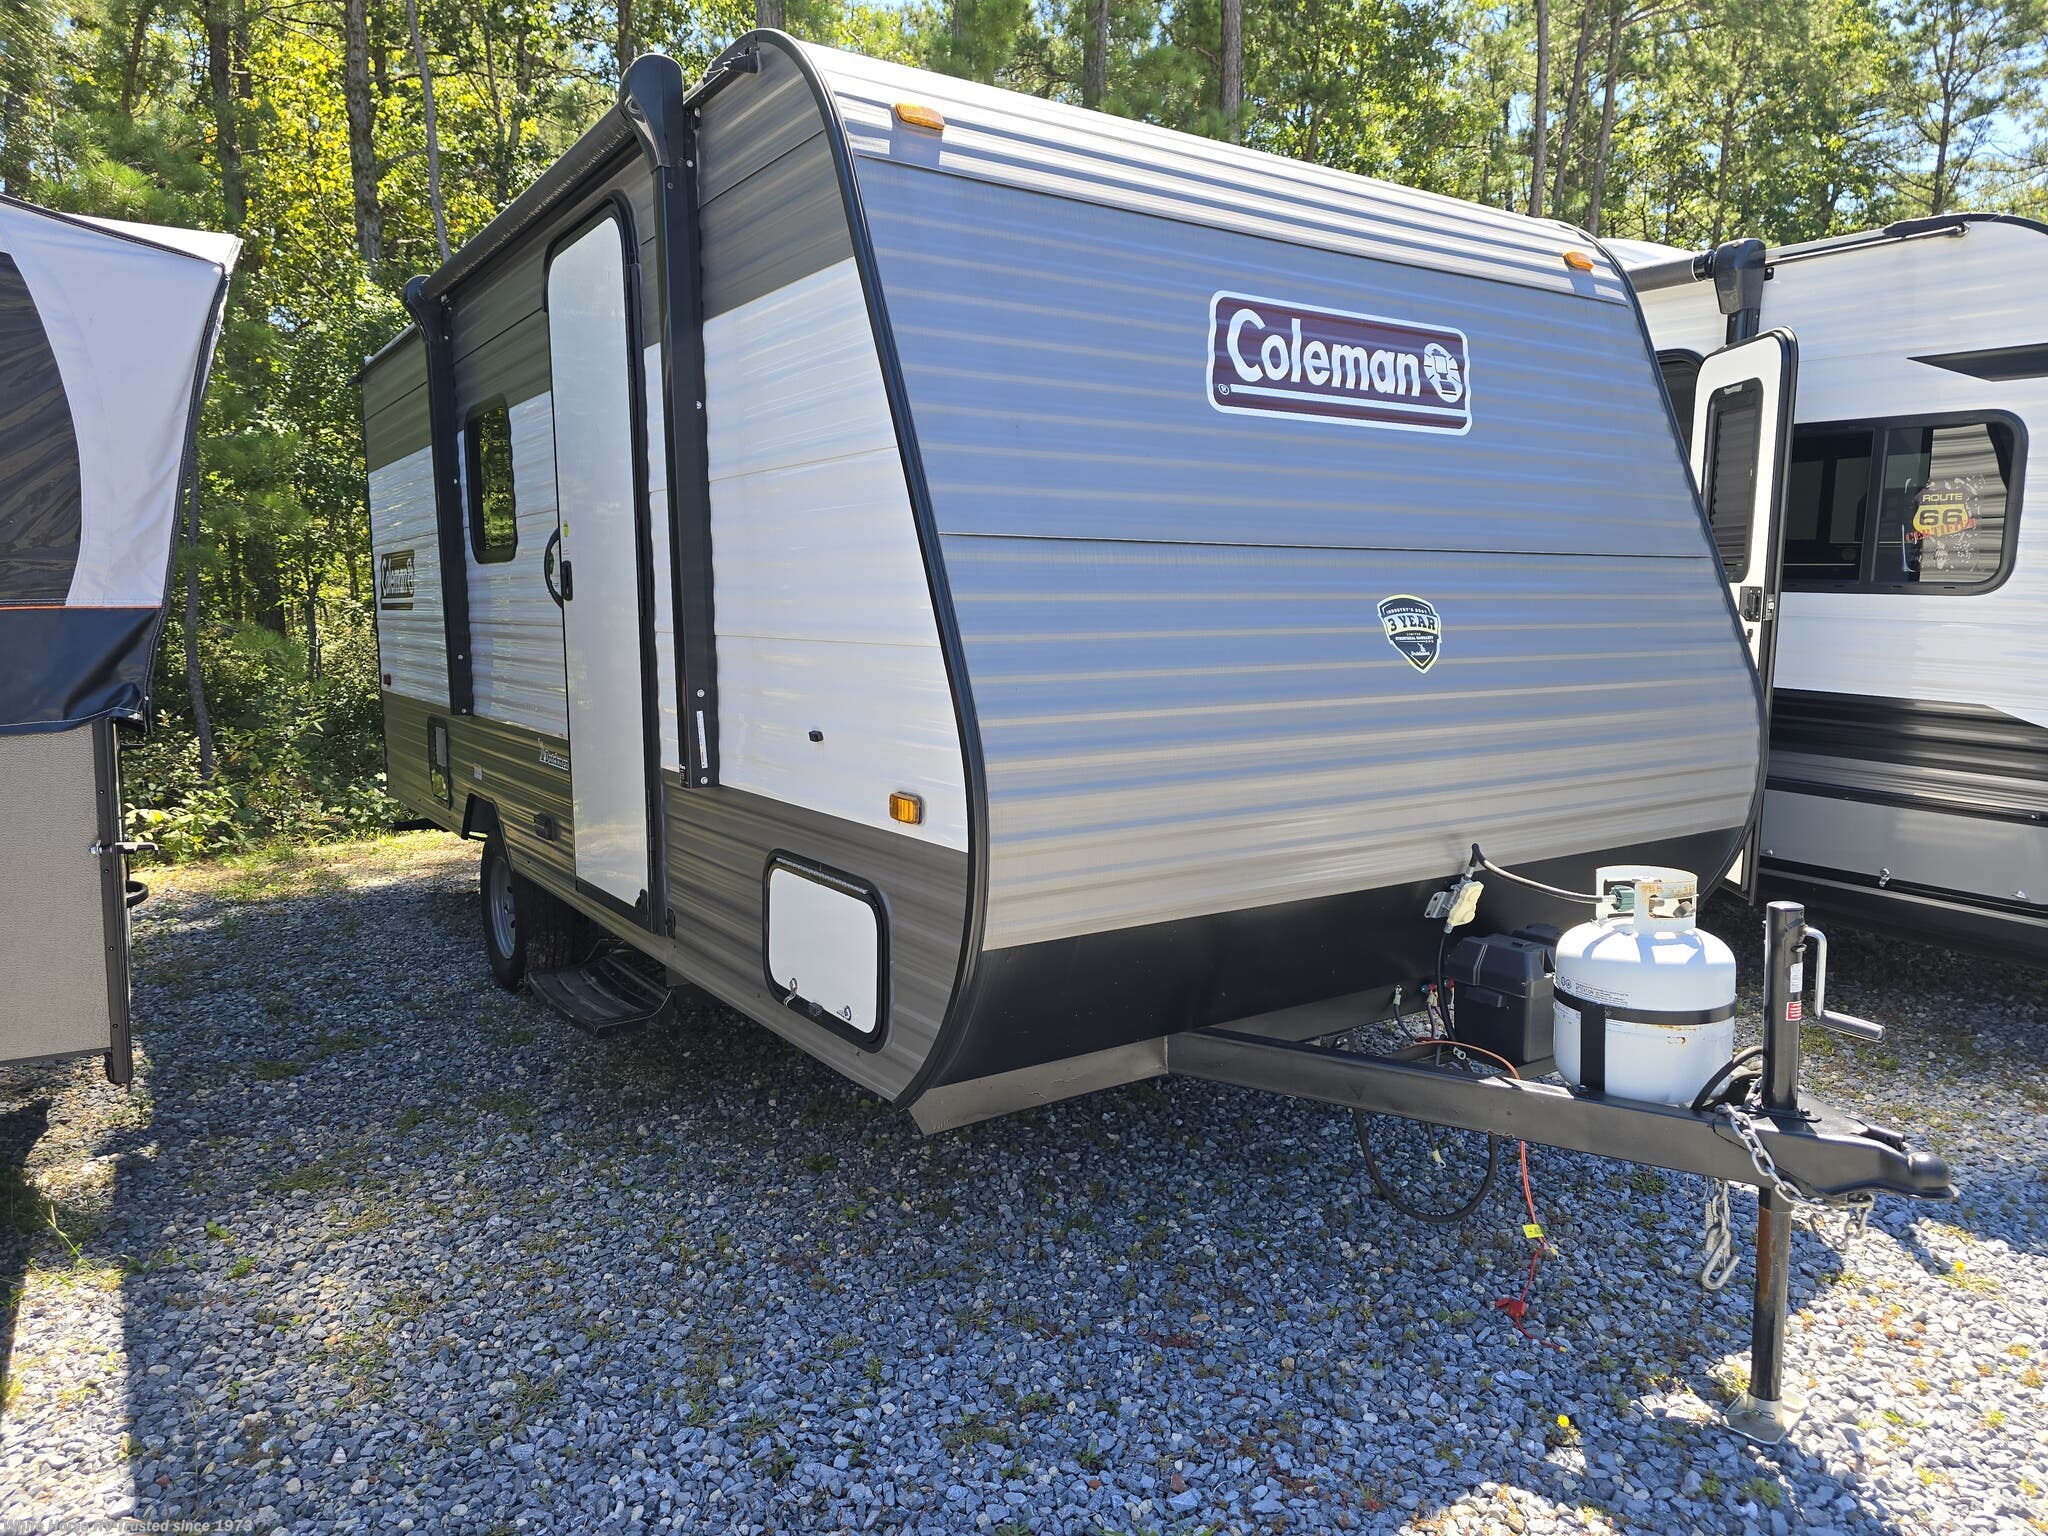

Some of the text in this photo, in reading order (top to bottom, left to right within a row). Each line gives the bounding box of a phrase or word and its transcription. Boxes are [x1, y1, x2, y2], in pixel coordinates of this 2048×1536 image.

[1226, 308, 1421, 397] Coleman
[1922, 492, 1964, 502] ROUTE
[1919, 508, 1963, 526] 66
[1387, 615, 1436, 631] 3 YEAR
